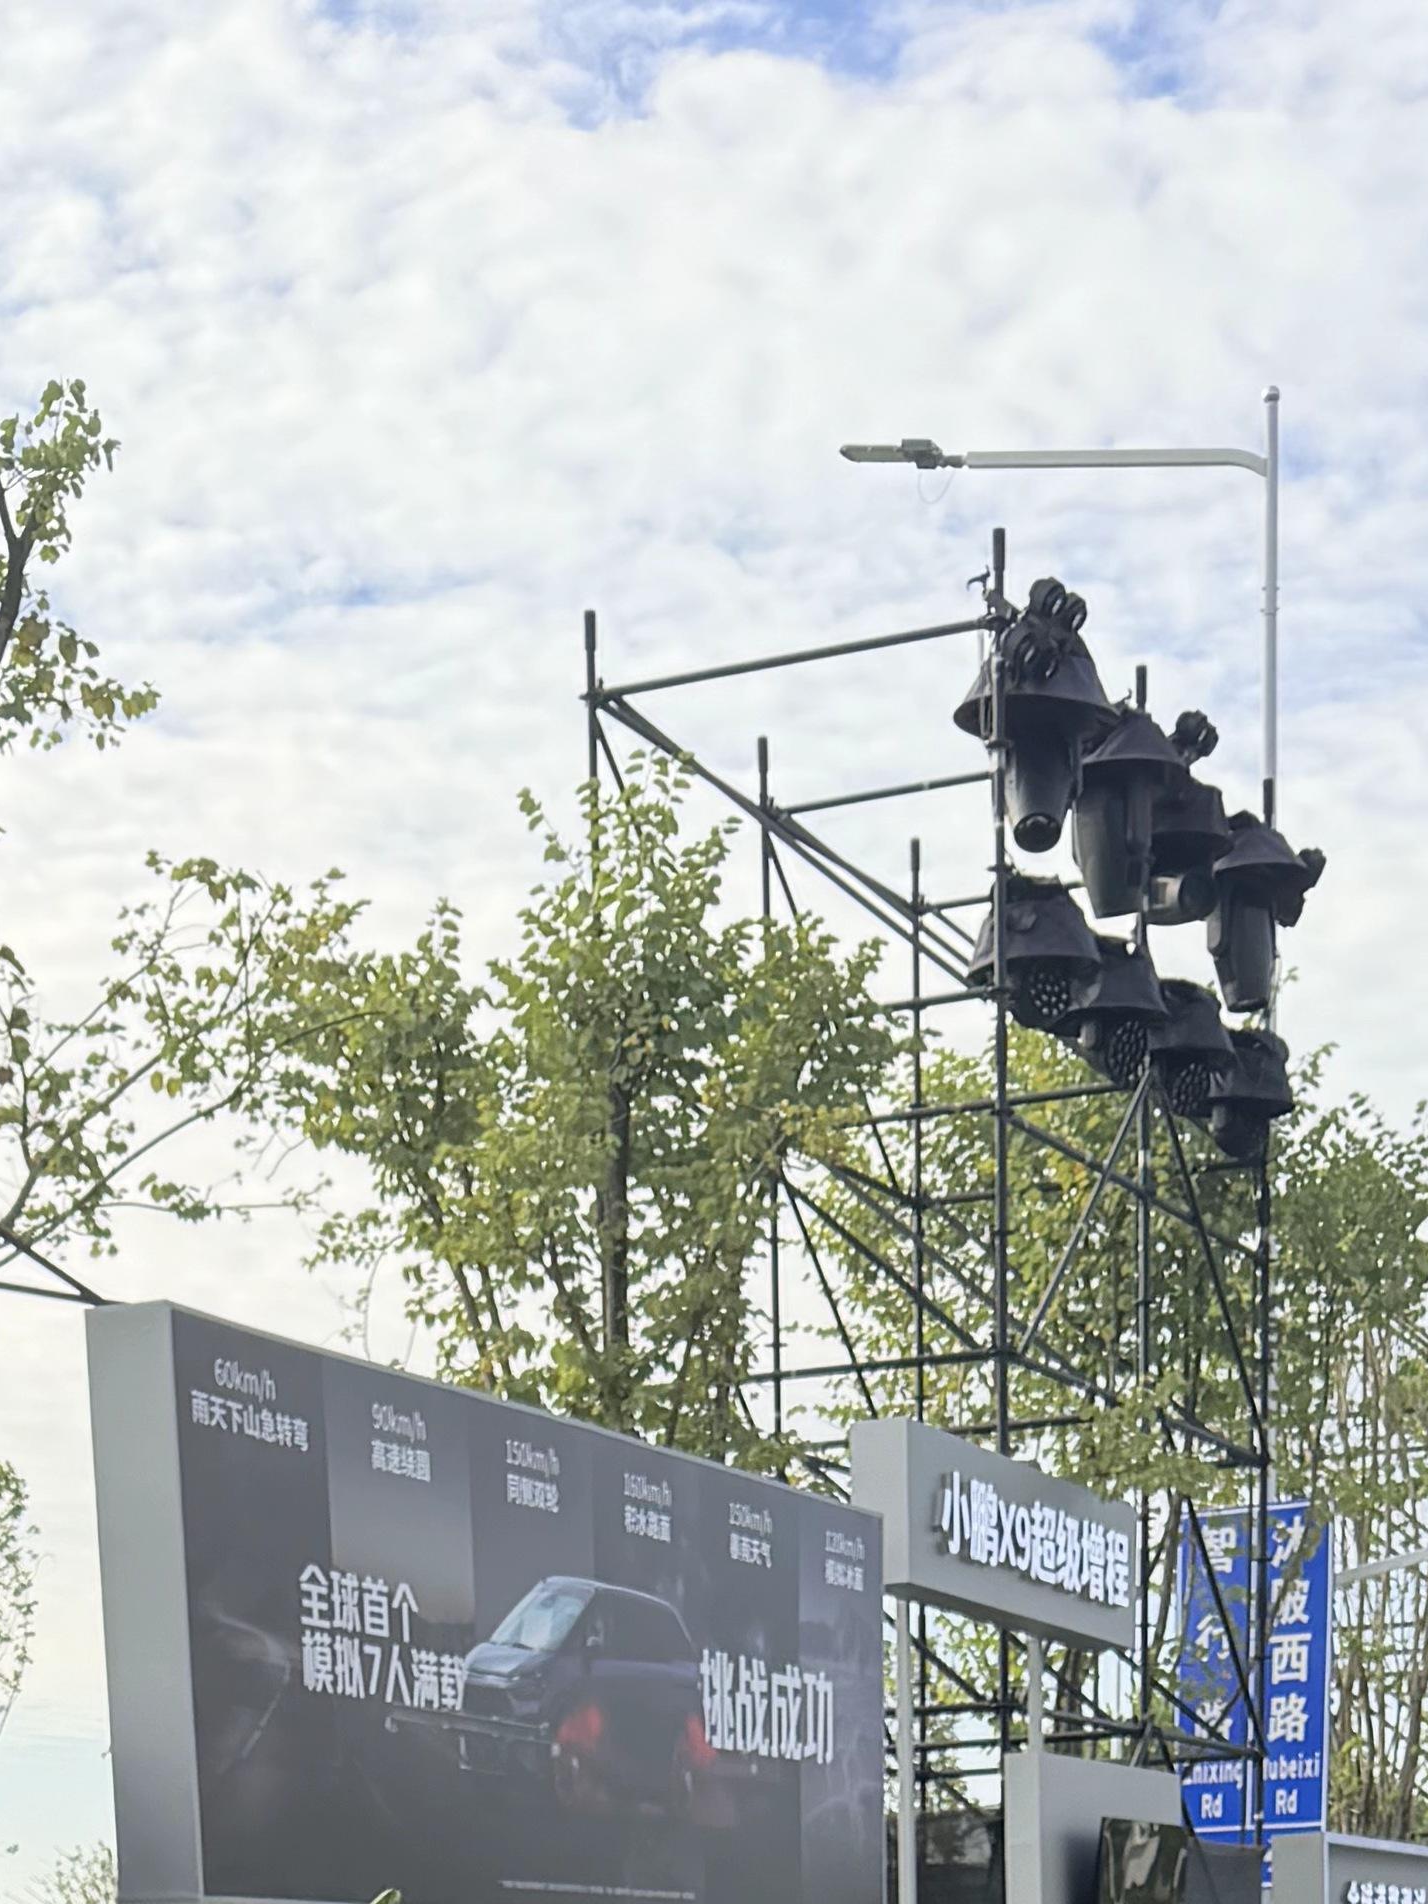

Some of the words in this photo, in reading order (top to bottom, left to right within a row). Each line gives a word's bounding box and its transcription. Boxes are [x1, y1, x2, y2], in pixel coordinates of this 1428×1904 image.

[213, 1357, 277, 1402] 60km/h
[190, 1389, 309, 1452] 雨天下山急转弯
[941, 1470, 1130, 1609] 小鹏X9超级增程
[298, 1563, 420, 1644] 全球首个
[301, 1629, 467, 1711] 模拟7人满载
[700, 1648, 834, 1766] 挑战成功
[1200, 1792, 1224, 1819] Rd
[1274, 1788, 1299, 1816] Rd
